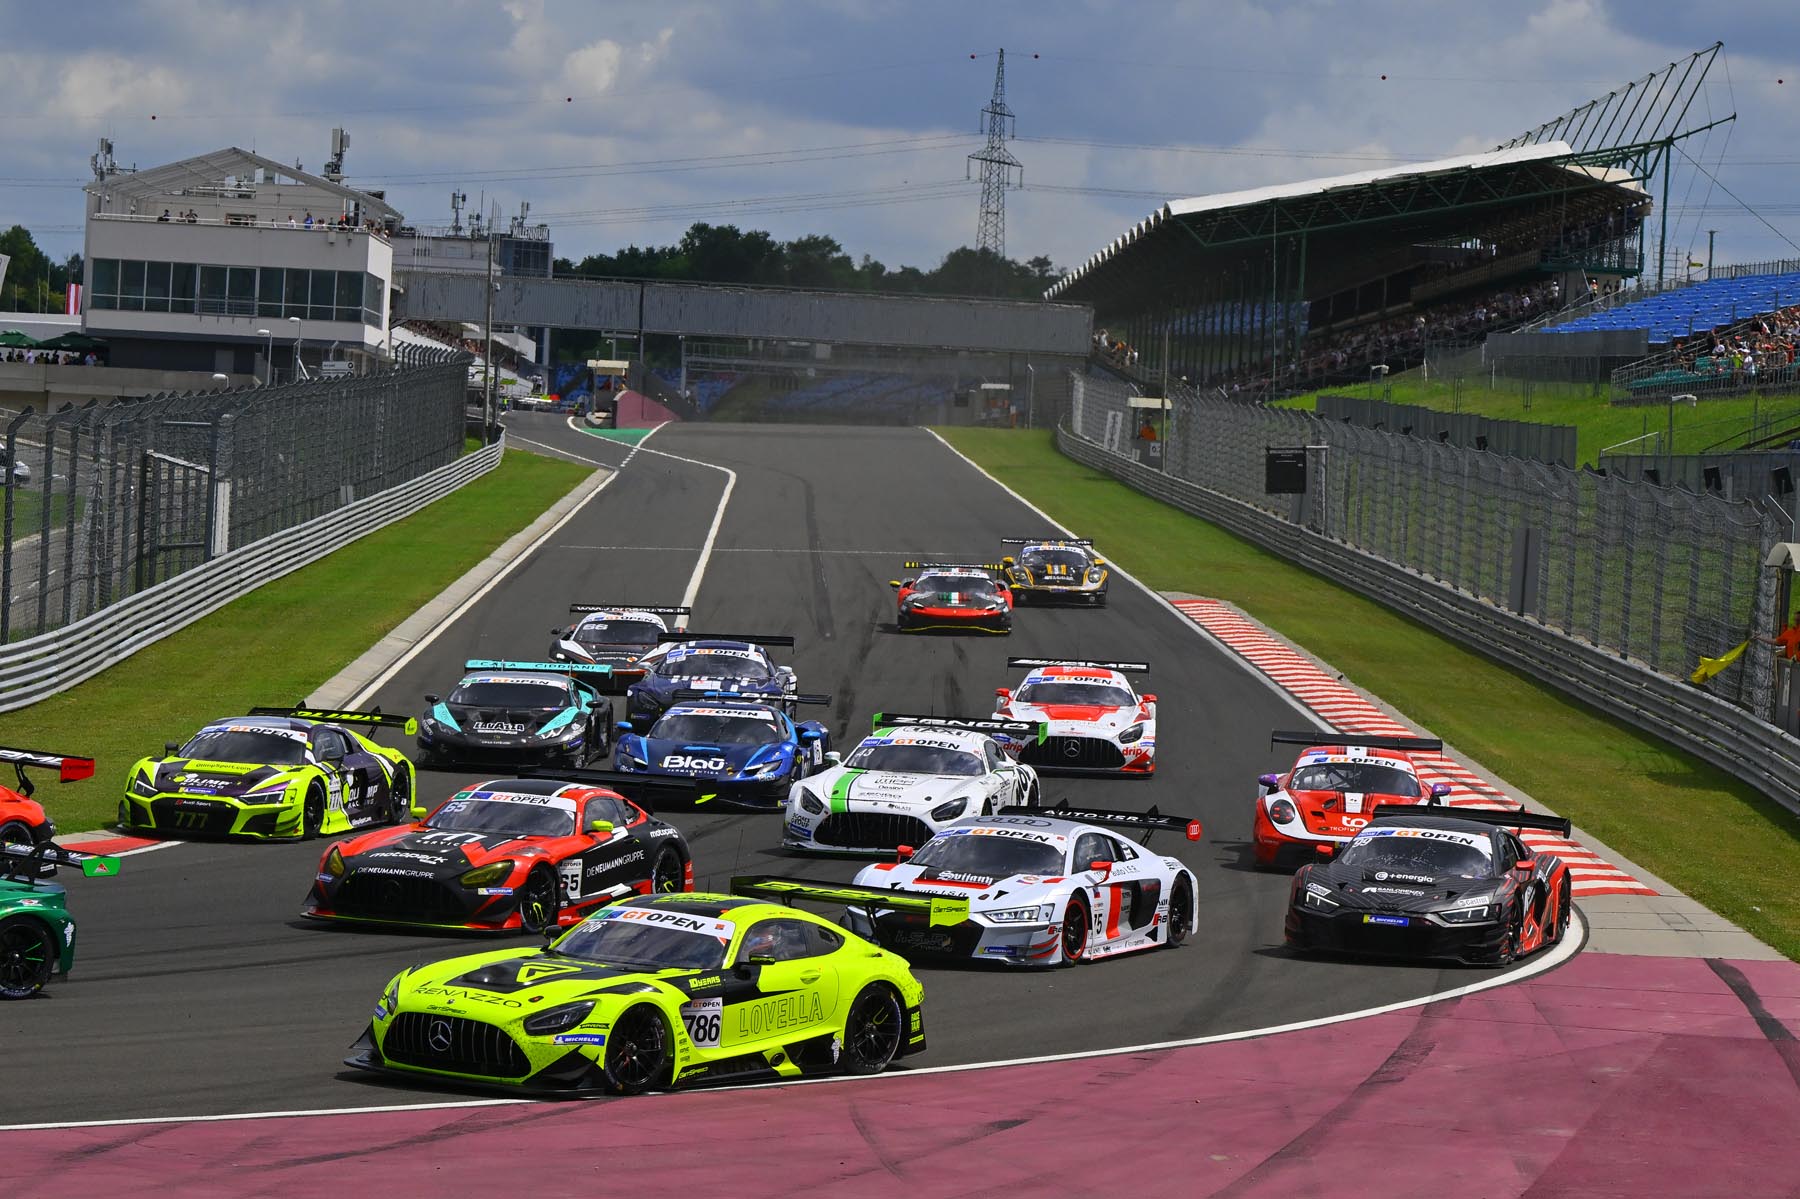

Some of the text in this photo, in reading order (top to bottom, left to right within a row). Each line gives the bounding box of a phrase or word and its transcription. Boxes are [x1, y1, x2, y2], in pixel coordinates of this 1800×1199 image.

[473, 721, 525, 732] LAVAZZA
[1003, 742, 1023, 752] drip
[1122, 746, 1142, 757] drip
[739, 992, 823, 1037] LOVELLA
[682, 1014, 720, 1042] 786
